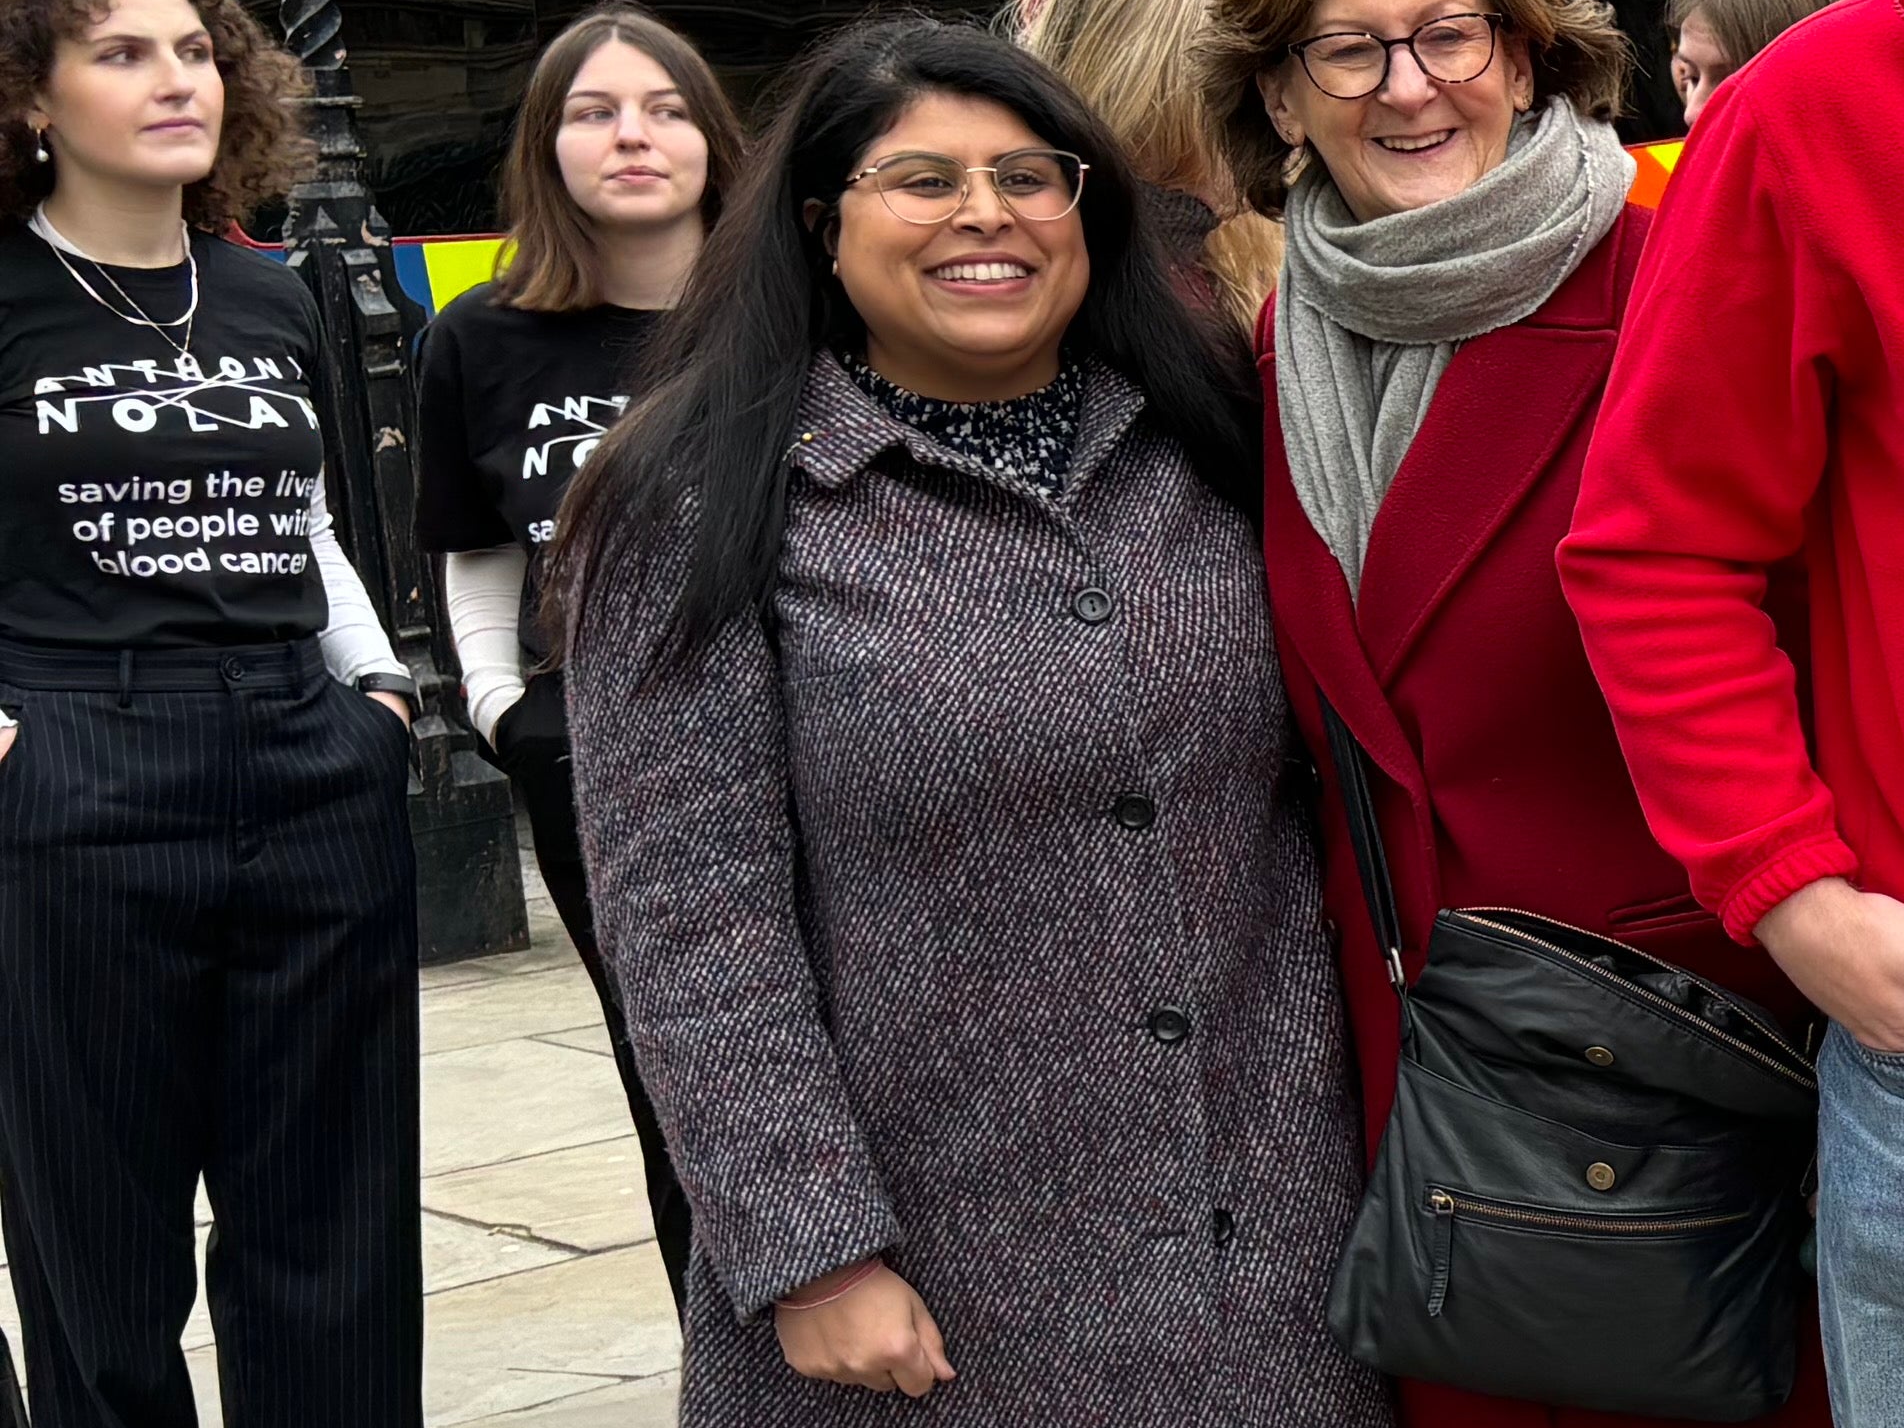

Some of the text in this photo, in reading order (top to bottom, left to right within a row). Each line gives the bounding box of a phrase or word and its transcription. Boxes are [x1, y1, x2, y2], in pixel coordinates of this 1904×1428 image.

[58, 469, 316, 504] saving the live
[72, 512, 115, 542] of
[126, 507, 260, 543] people
[91, 547, 211, 576] blood
